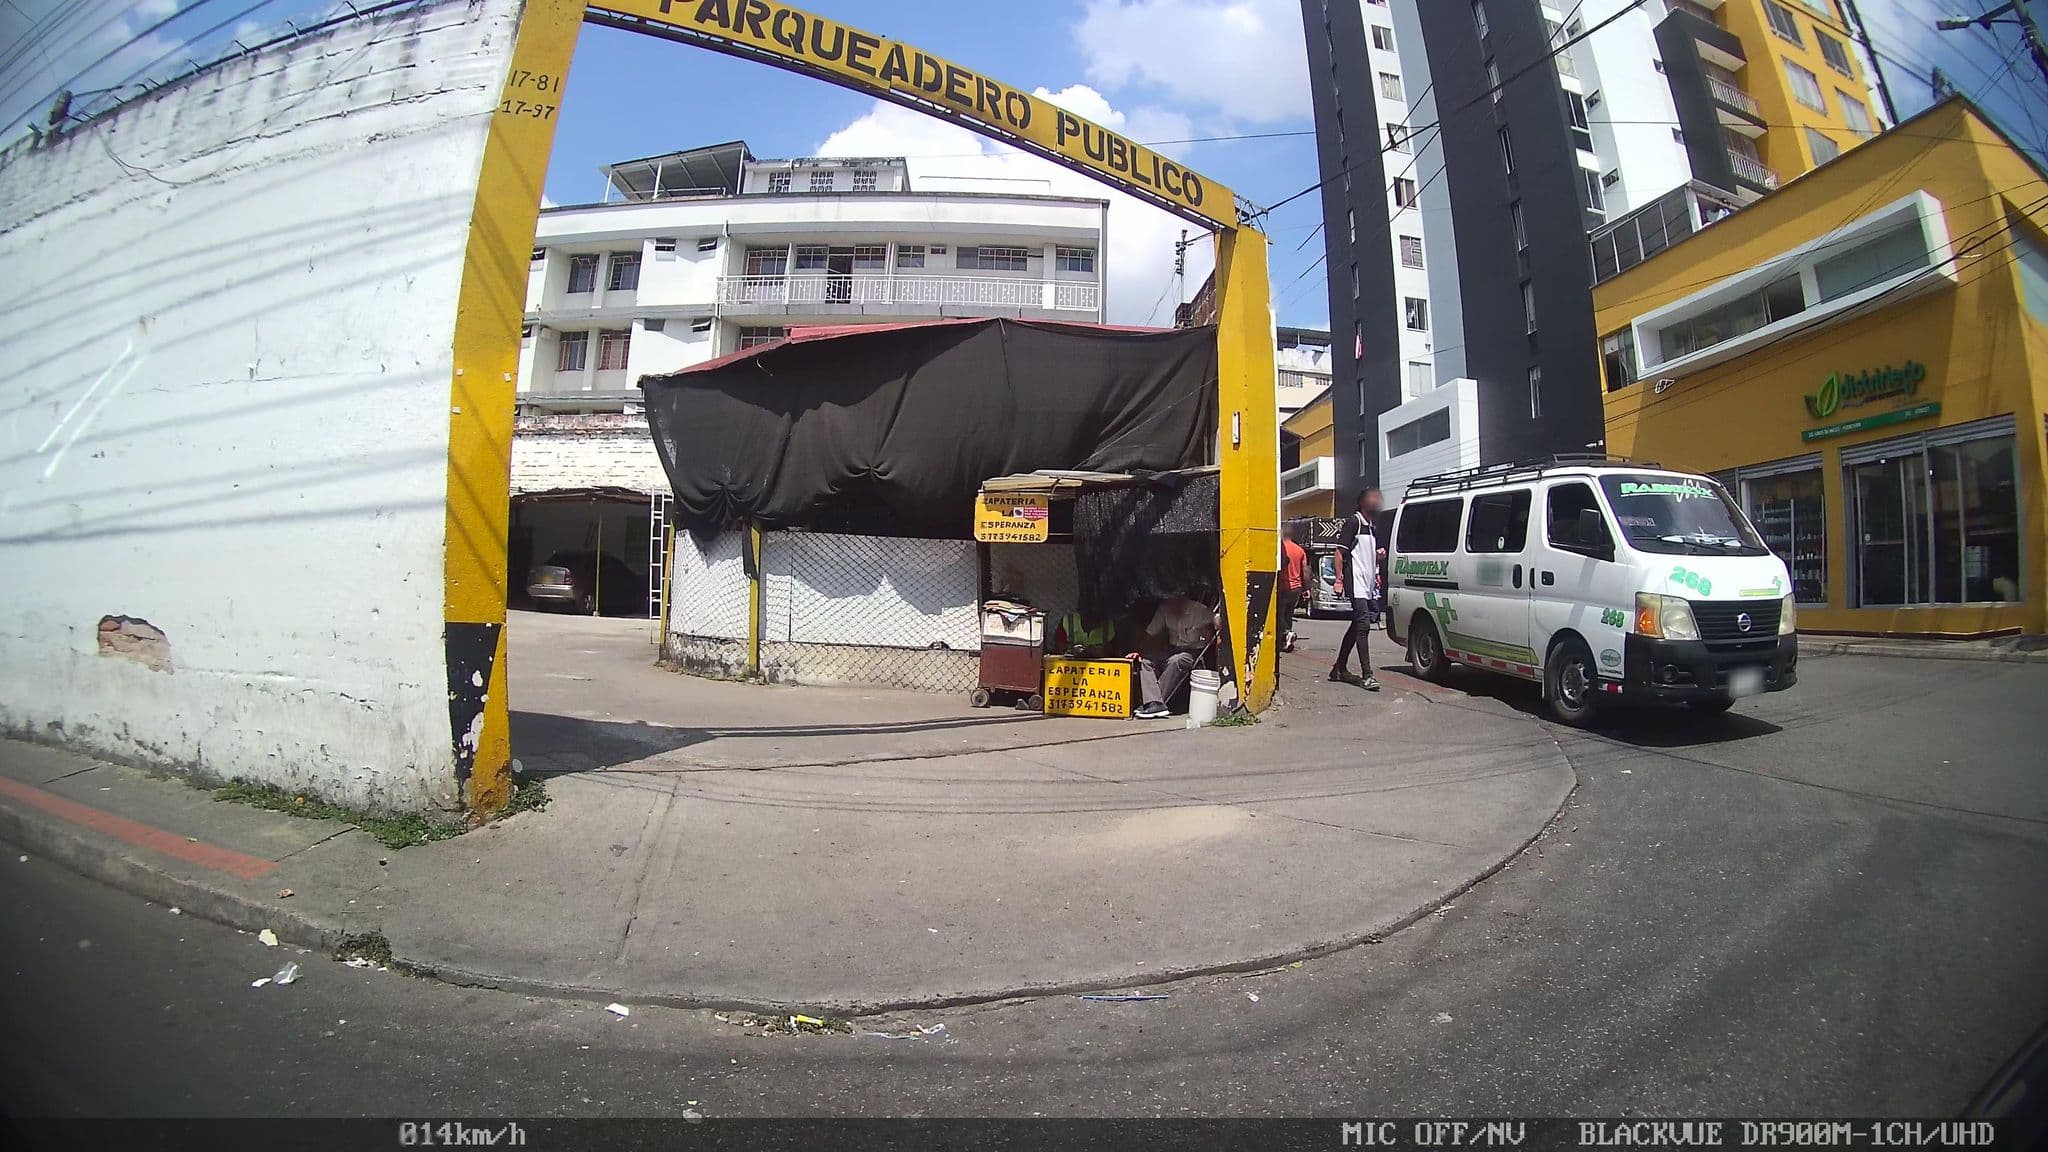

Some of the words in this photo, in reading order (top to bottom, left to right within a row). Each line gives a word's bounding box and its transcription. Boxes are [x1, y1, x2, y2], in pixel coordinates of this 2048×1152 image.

[510, 69, 560, 93] 17-81
[502, 99, 556, 120] 17-97
[1057, 111, 1204, 207] PUBLICO
[982, 497, 1036, 505] ZAPATERIA
[1002, 509, 1015, 517] LA
[980, 521, 1036, 529] ESPERANZA
[980, 532, 1041, 541] 3173941582
[1048, 666, 1121, 678] ZAPATERIA
[1072, 677, 1088, 687] LA
[1048, 686, 1121, 701] ESPERANZA
[1047, 698, 1124, 714] 3173941582
